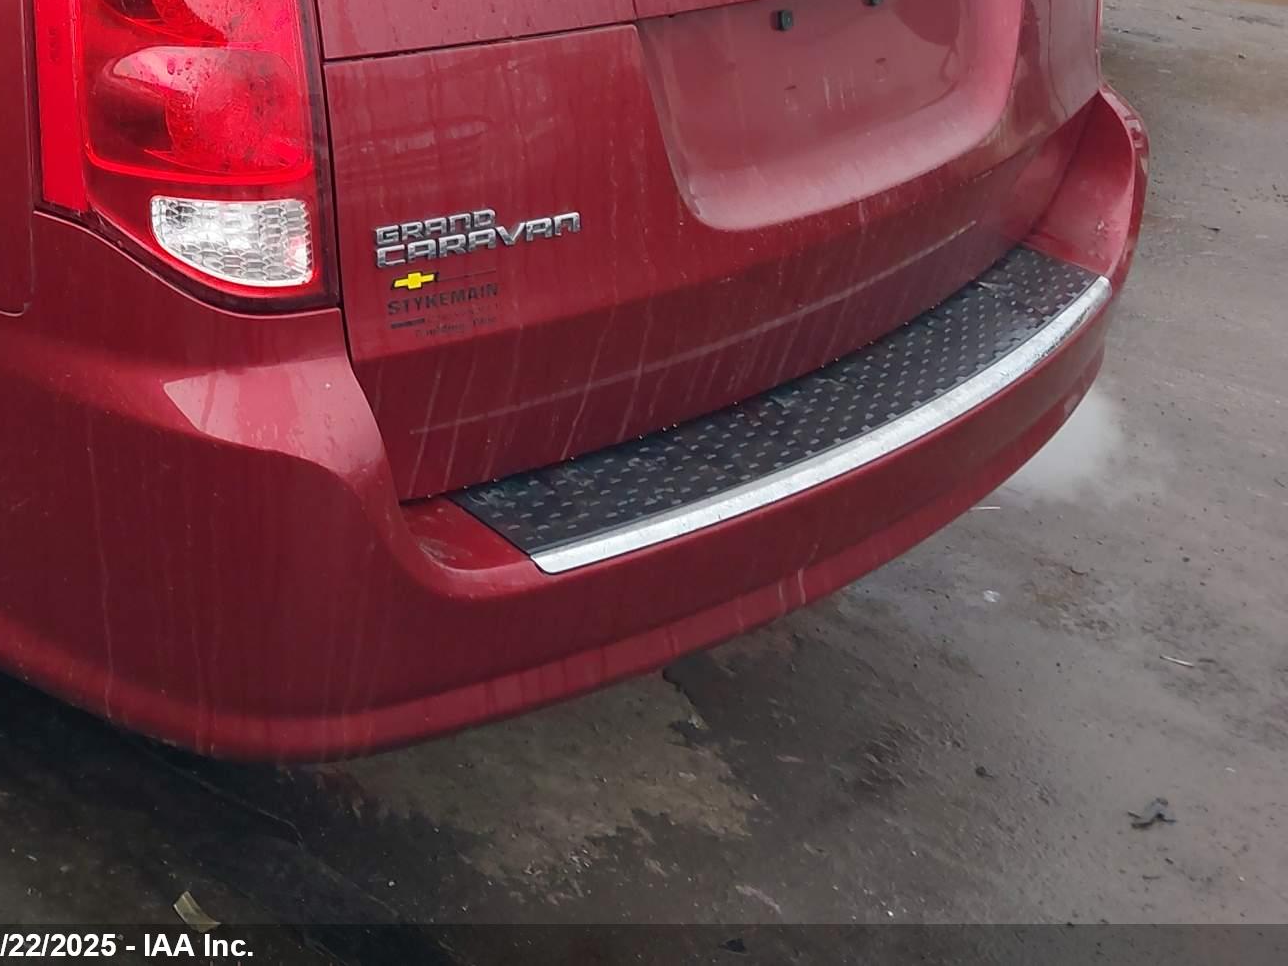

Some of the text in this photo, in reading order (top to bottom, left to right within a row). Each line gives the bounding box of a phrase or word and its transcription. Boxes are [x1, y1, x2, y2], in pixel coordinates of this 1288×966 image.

[375, 208, 496, 245] GRAND
[376, 211, 581, 268] CARAVAN
[388, 283, 498, 315] STYKEMAIN
